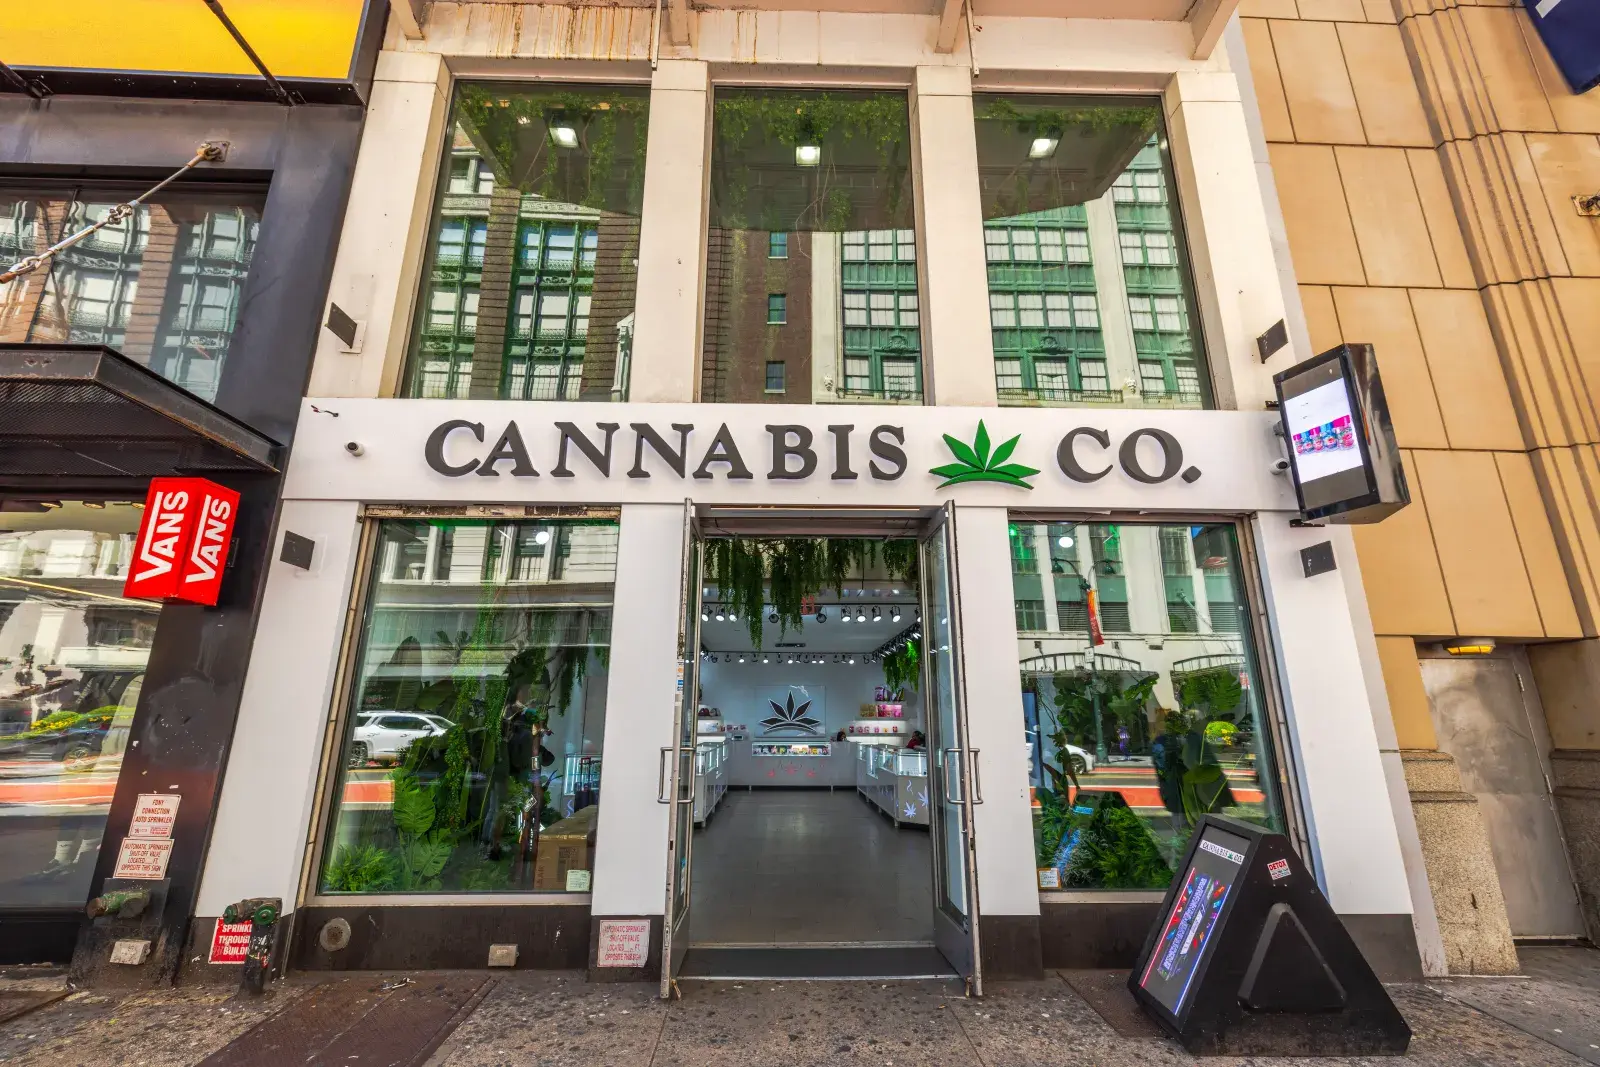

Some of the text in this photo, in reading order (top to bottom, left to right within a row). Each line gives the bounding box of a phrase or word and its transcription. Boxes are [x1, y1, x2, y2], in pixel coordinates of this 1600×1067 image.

[424, 419, 1203, 485] CANNABIS CO.
[134, 491, 189, 583] VANS
[185, 494, 231, 583] VANS
[1268, 860, 1286, 870] DETOX
